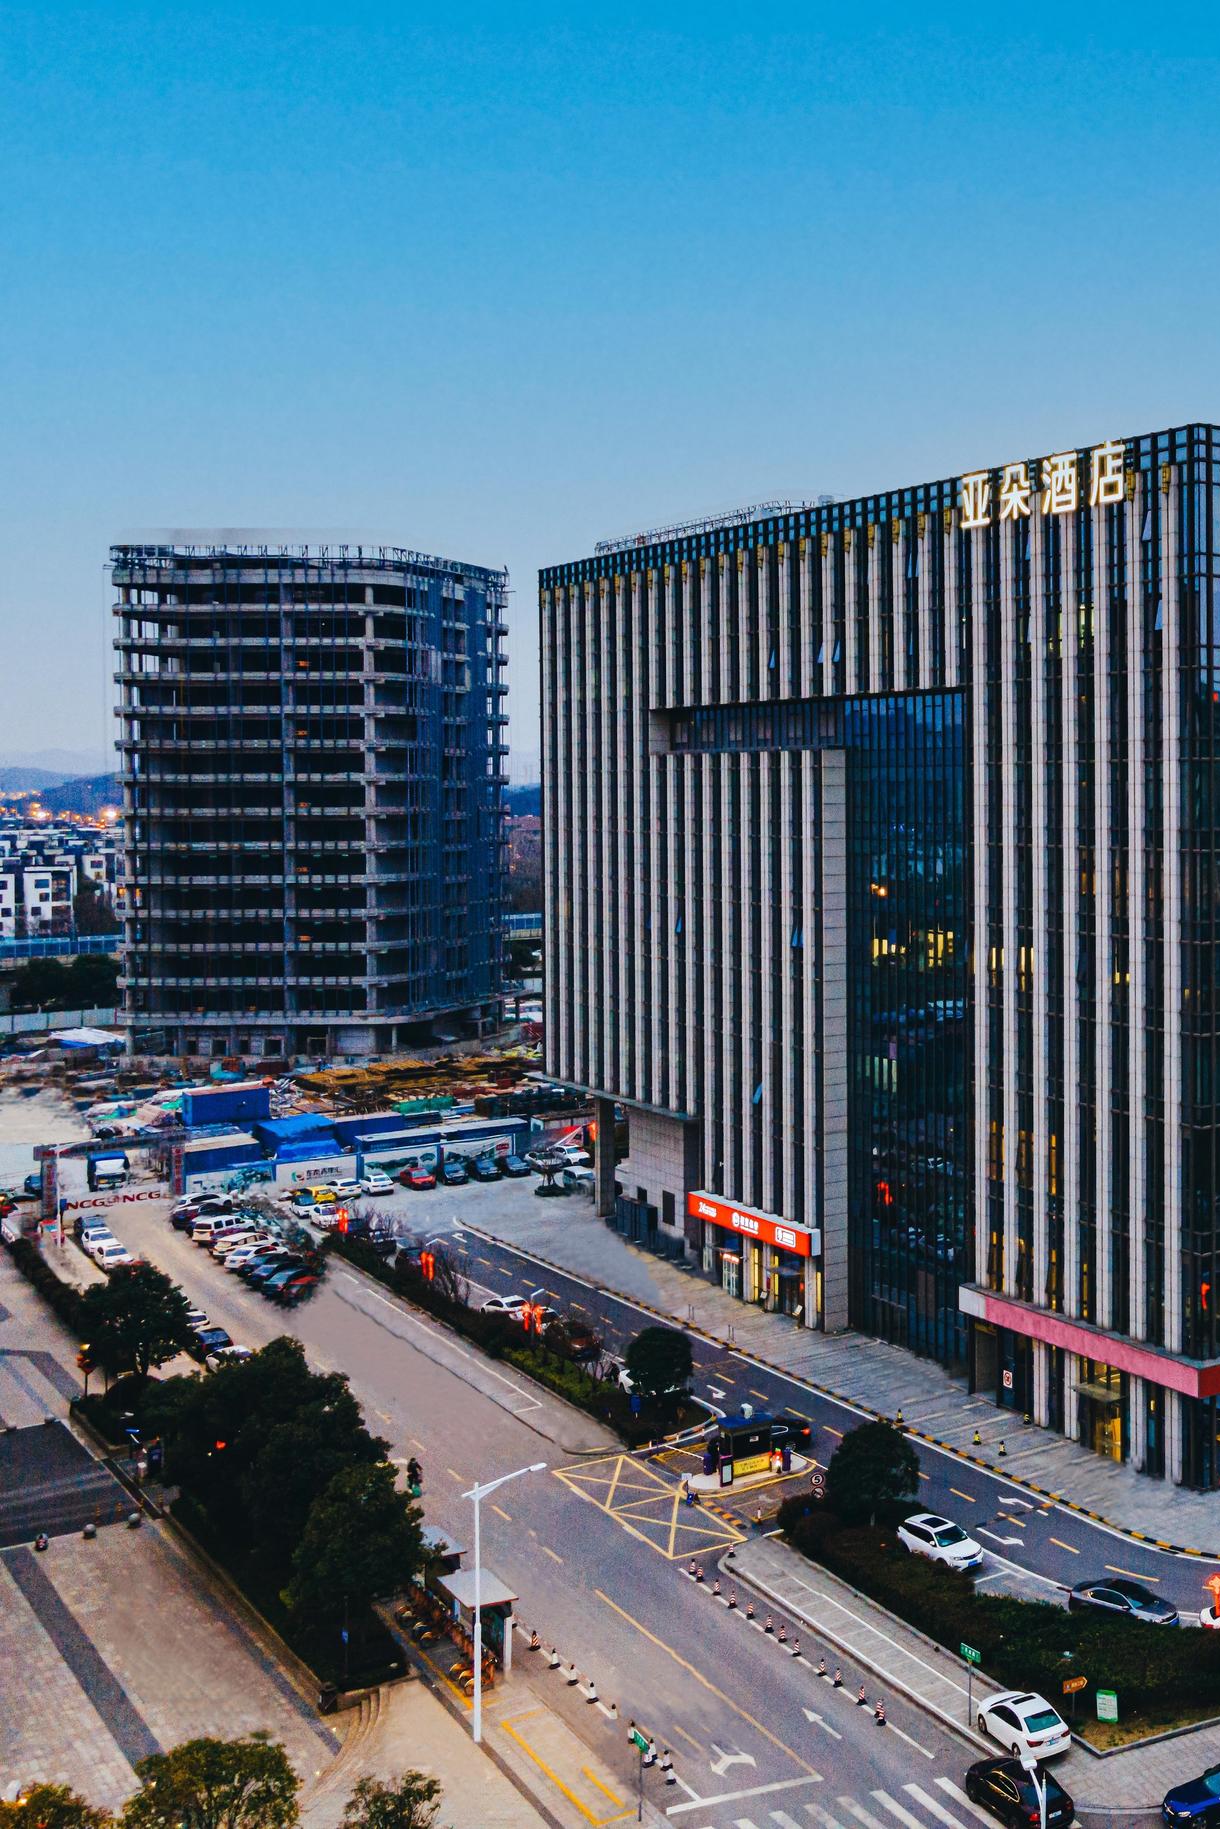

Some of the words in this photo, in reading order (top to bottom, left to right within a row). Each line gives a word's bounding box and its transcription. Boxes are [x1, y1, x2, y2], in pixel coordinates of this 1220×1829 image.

[961, 441, 1126, 529] 亚朵酒店
[122, 1190, 161, 1203] NCG
